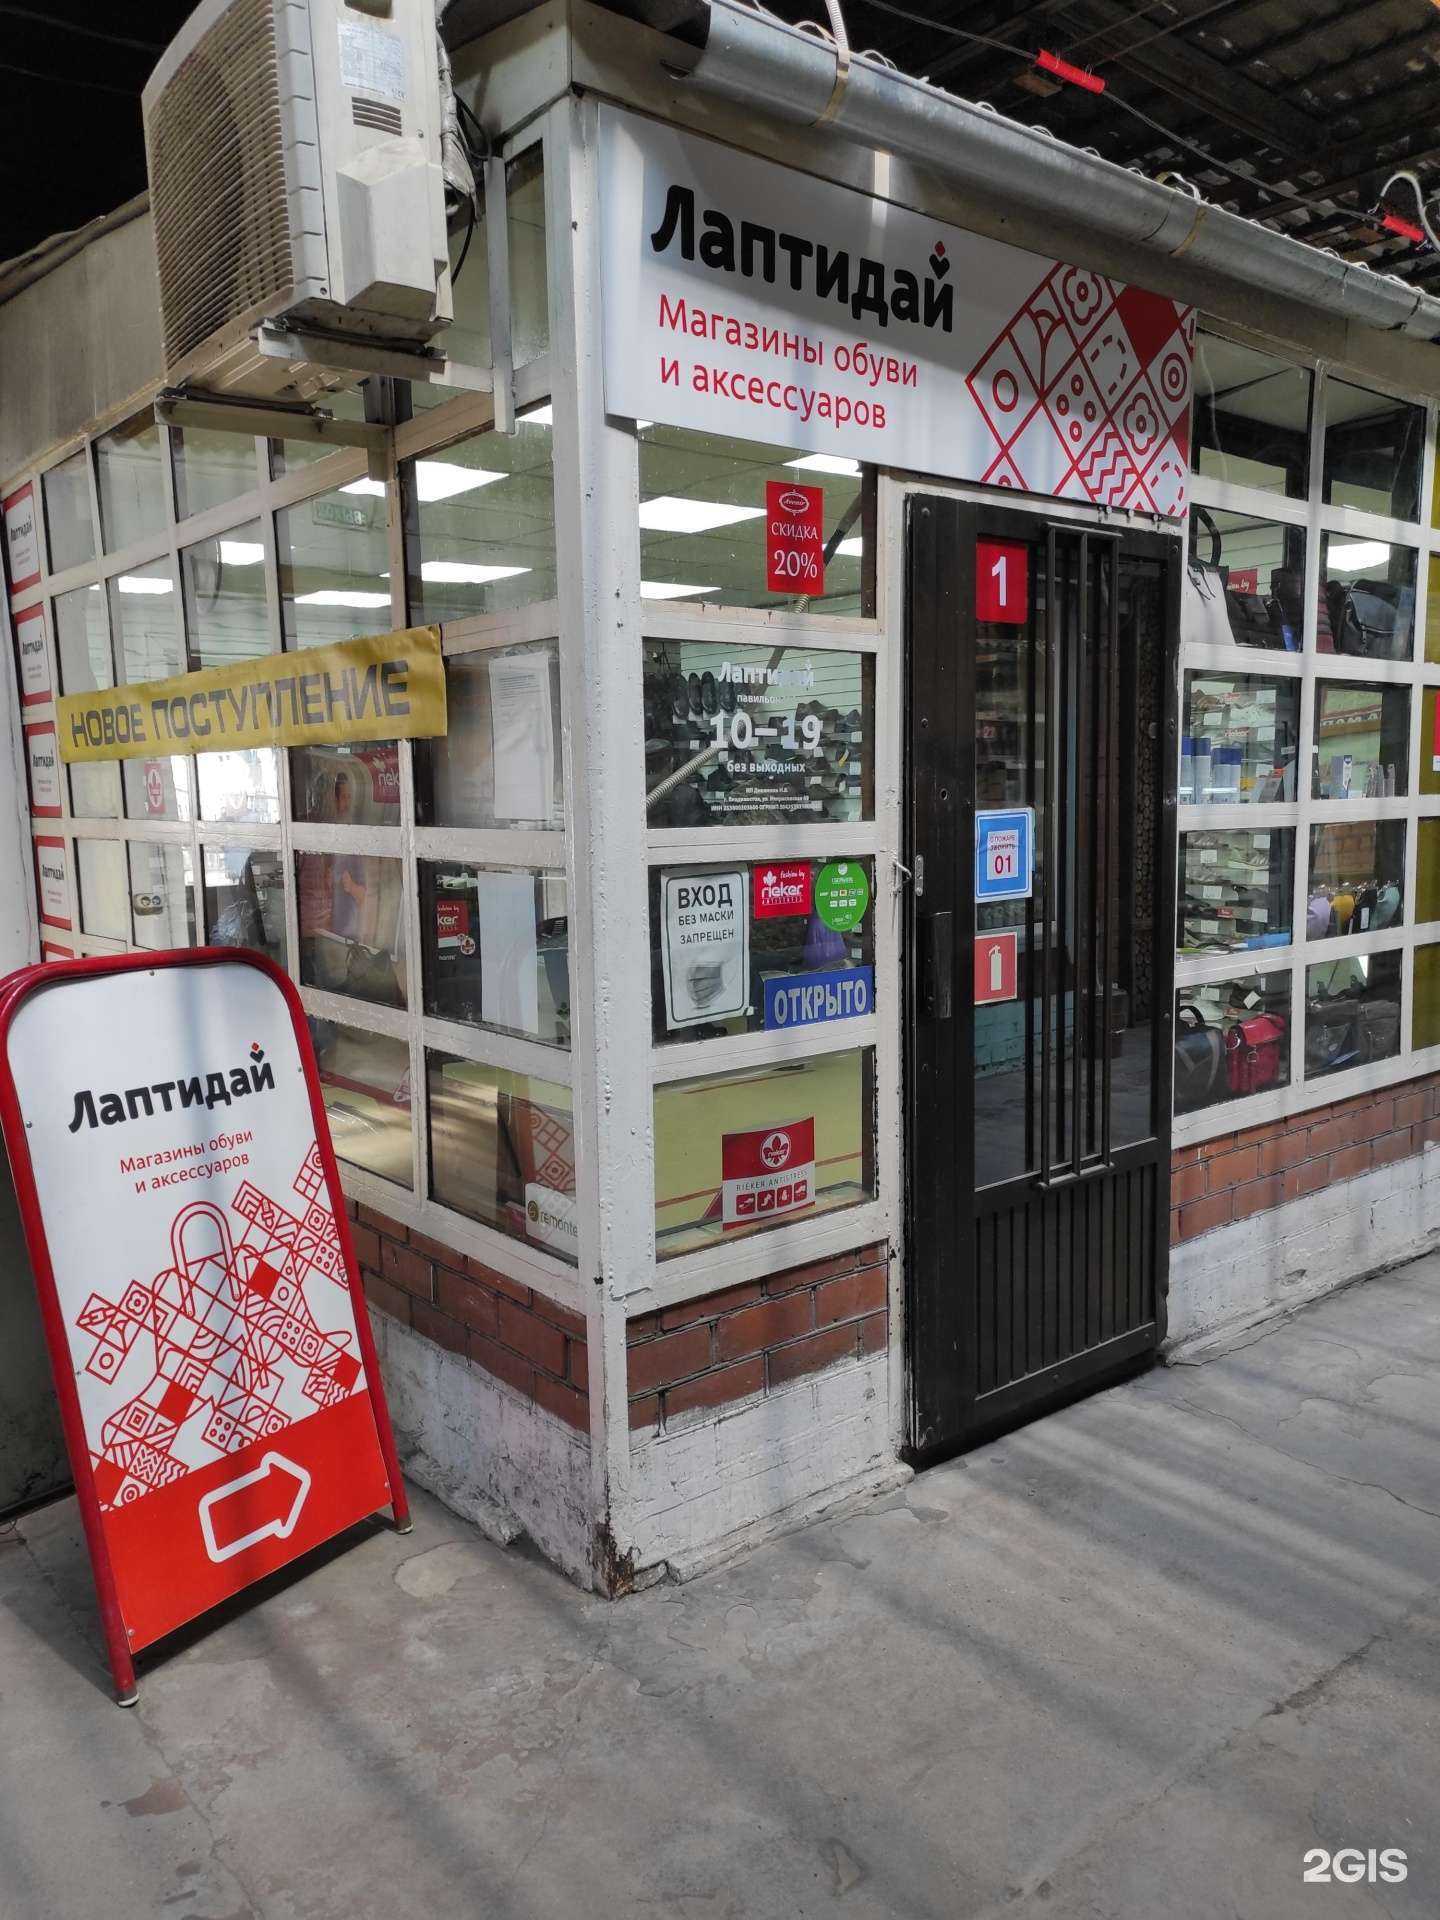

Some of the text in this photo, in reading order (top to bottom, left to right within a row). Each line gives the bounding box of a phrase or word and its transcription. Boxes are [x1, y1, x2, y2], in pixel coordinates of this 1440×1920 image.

[651, 184, 954, 333] Лаптидай
[658, 293, 918, 389] Магазины обуви
[660, 354, 887, 430] и аксессуаров
[771, 521, 819, 542] СКИДКА
[773, 549, 818, 579] 20%
[991, 555, 1007, 607] 1
[718, 658, 815, 688] Лаптий
[70, 659, 411, 748] НОВОЕ ПОСТУПЛЕНИЕ
[727, 760, 806, 775] без выходных
[994, 854, 1012, 874] 01
[678, 883, 733, 910] ВХОД
[761, 881, 804, 899] rieker
[678, 909, 735, 926] БЕЗ МАСКИ
[680, 929, 735, 945] ЗАПРЕЩЕН
[774, 978, 867, 1025] ОТКРЫТО
[68, 1041, 275, 1134] Лаптидай
[119, 1129, 254, 1174] Магазины обуви
[134, 1151, 250, 1194] и аксессуаров
[540, 1210, 578, 1238] remonte
